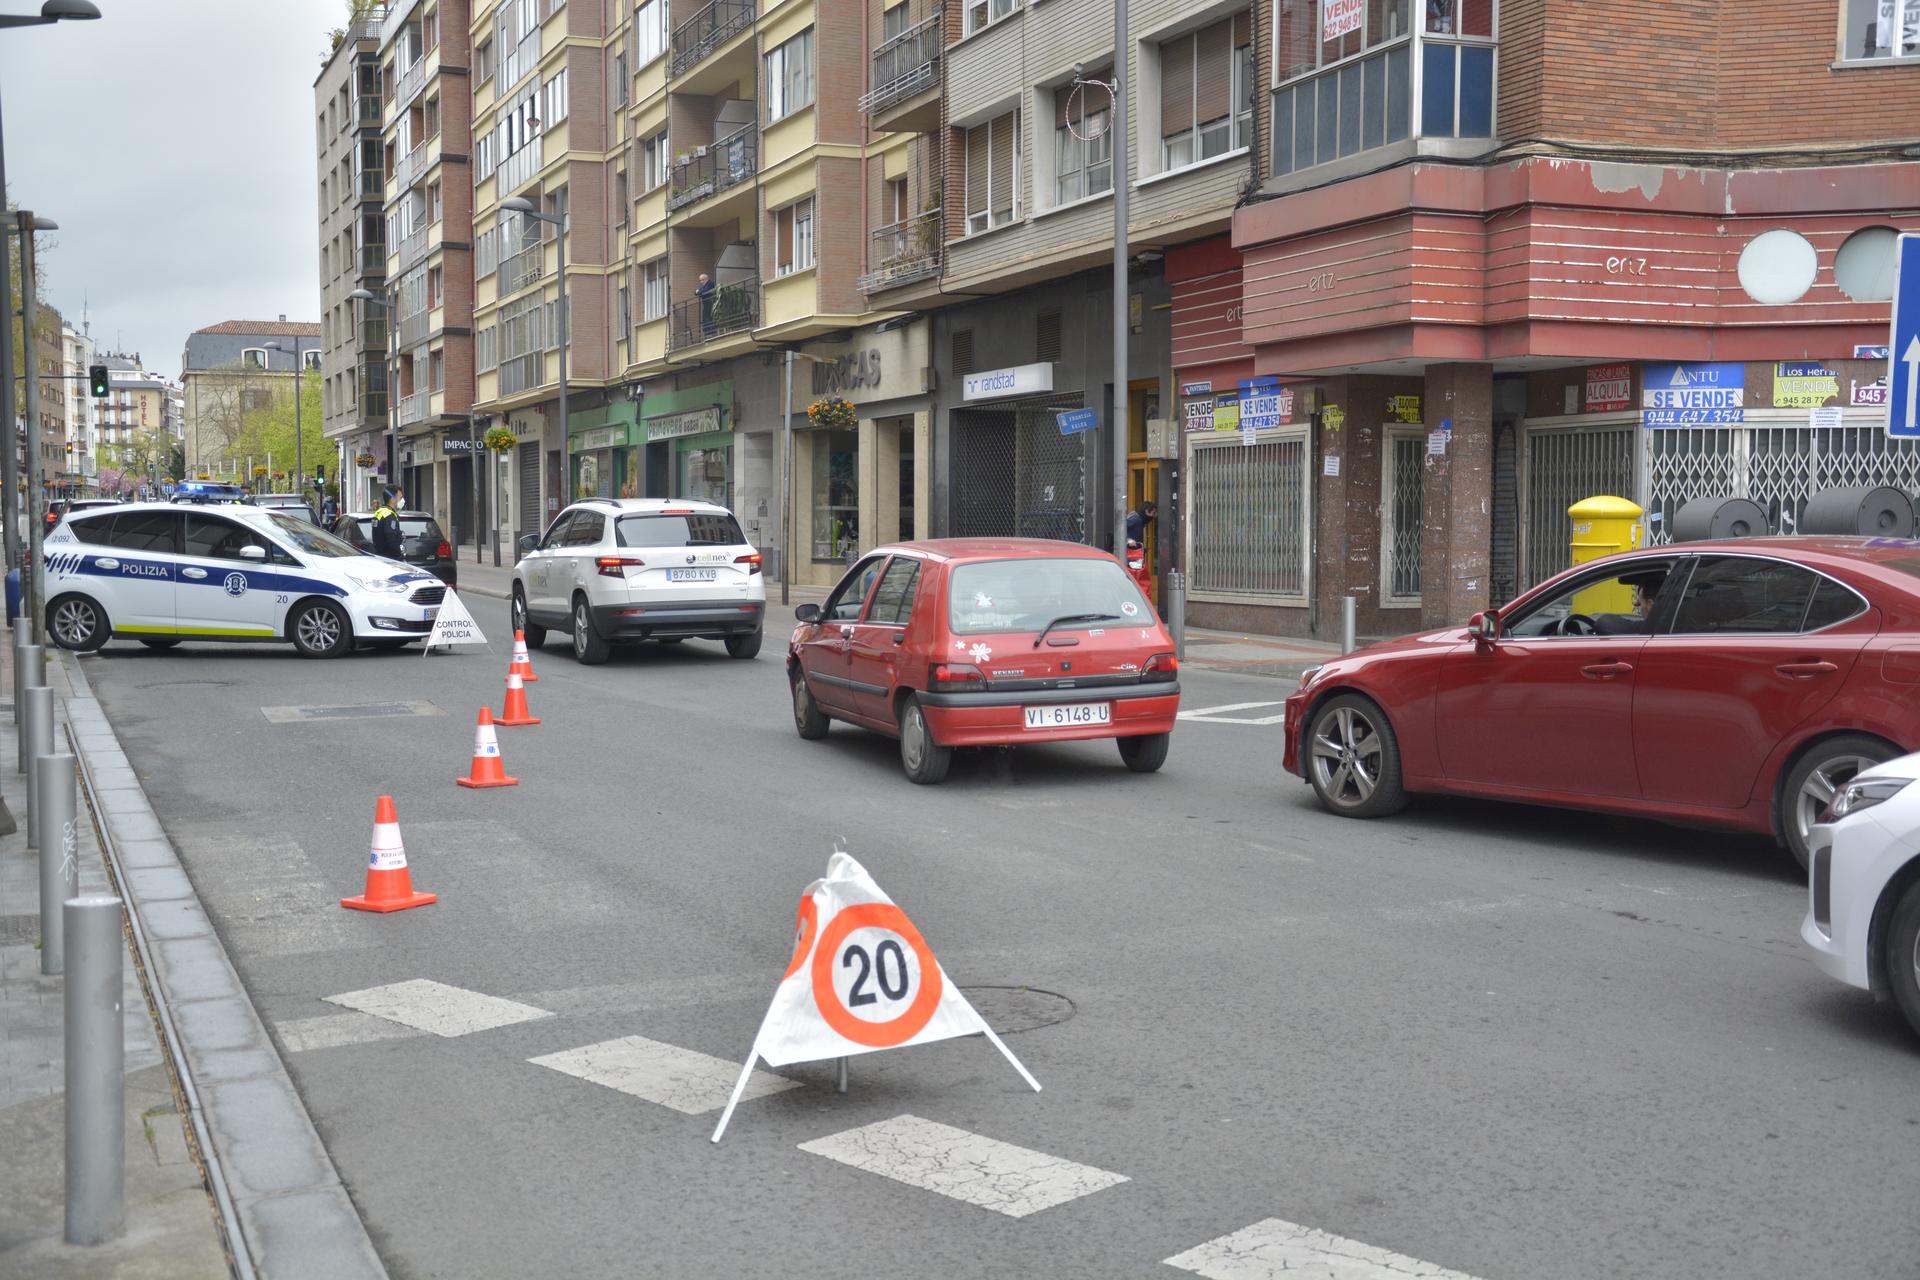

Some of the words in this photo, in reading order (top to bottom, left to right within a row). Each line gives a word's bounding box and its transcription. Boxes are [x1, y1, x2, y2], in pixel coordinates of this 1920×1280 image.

[1606, 256, 1648, 276] ertz
[1308, 272, 1335, 292] ertz
[1226, 305, 1243, 322] ert
[1668, 365, 1719, 386] ANTU
[1787, 369, 1803, 377] LOS
[980, 369, 1016, 393] randstad
[1781, 379, 1835, 393] VENDE
[1587, 381, 1630, 401] ALQUILA
[1857, 389, 1880, 402] 945
[1244, 400, 1253, 415] SE
[1254, 397, 1278, 414] VENDE
[1653, 391, 1675, 408] SE
[1680, 390, 1735, 408] VENDE
[1782, 396, 1799, 404] 945
[1801, 396, 1812, 404] 28
[1647, 411, 1675, 423] 944
[1679, 410, 1709, 423] 647
[1712, 410, 1741, 423] 354
[444, 440, 484, 450] IMPACO
[122, 563, 168, 577] POLIZIA
[673, 569, 697, 579] 8780
[699, 569, 717, 579] KVB
[277, 594, 288, 604] 20
[436, 620, 473, 628] CONTROL
[441, 630, 471, 639] POLICIA
[842, 939, 909, 1007] 20
